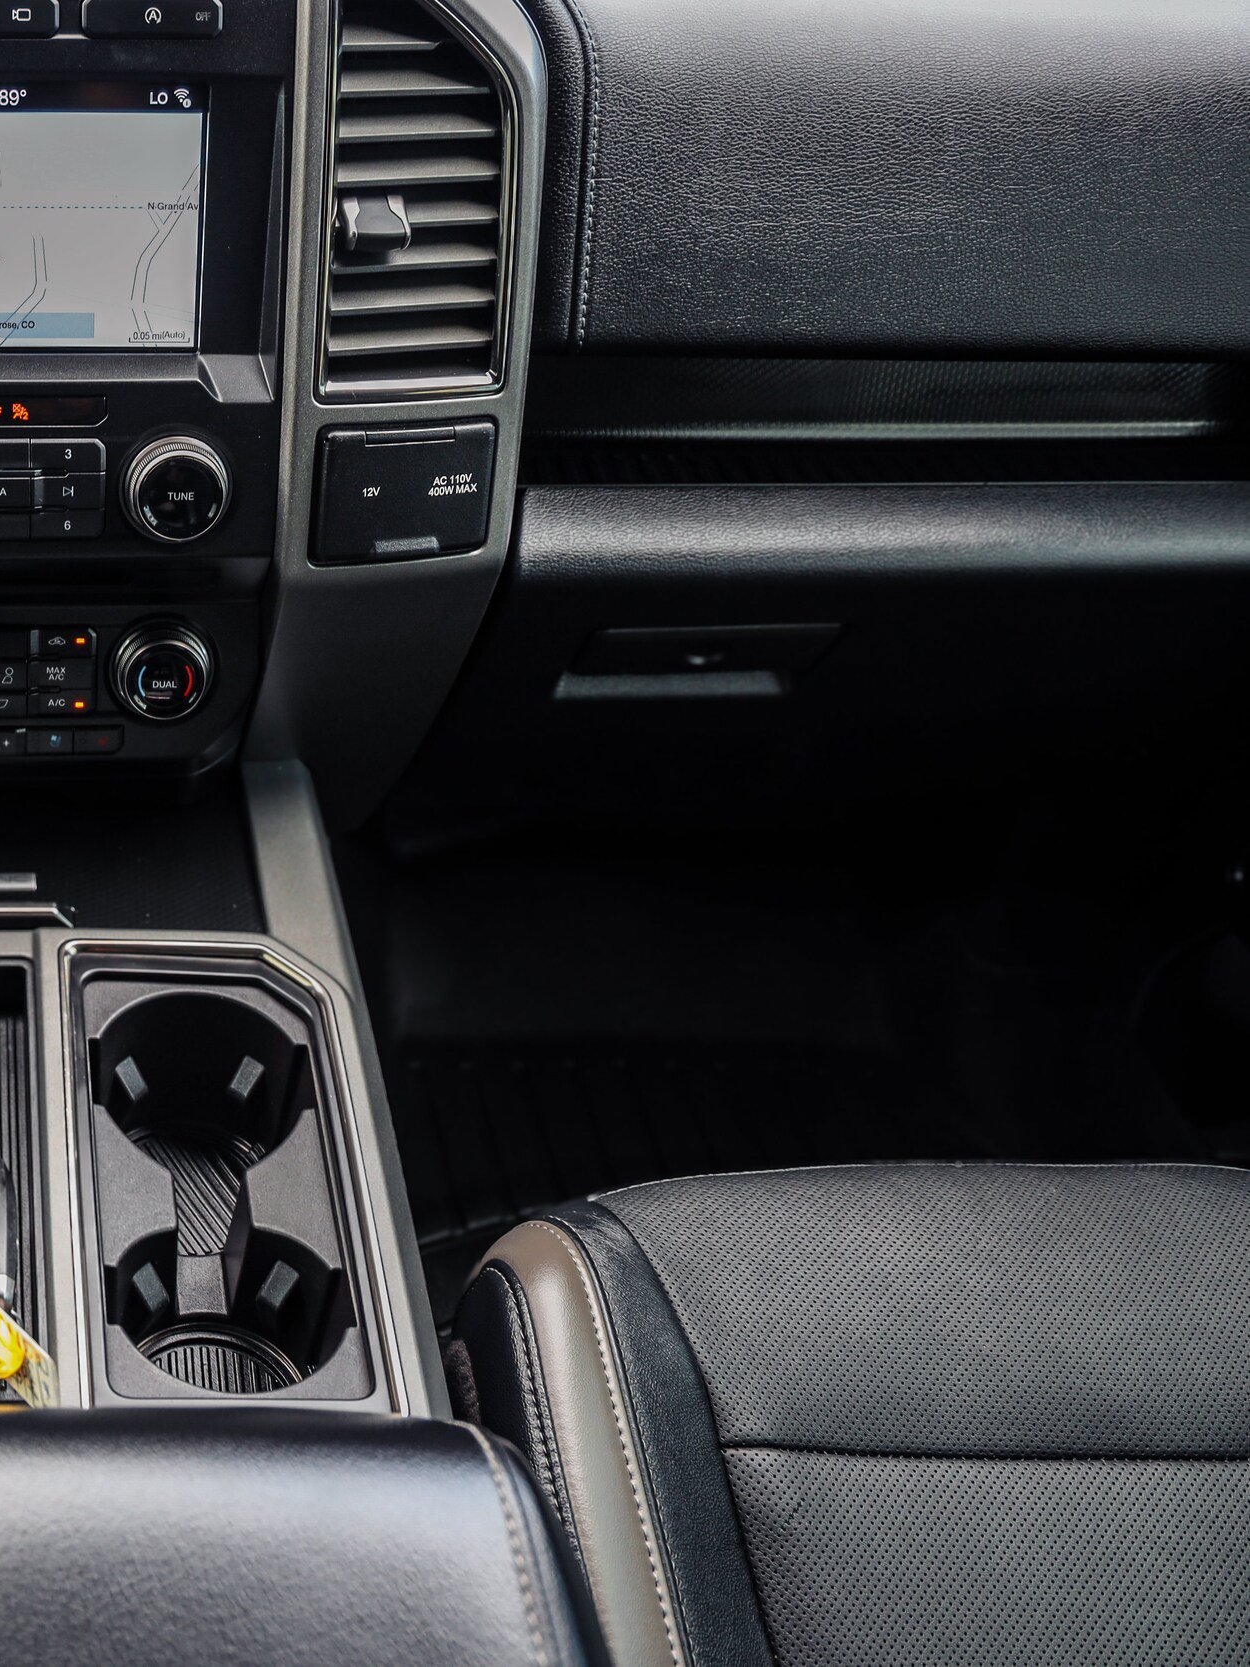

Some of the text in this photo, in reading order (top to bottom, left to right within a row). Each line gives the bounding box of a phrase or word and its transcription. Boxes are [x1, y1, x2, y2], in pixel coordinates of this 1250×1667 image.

[150, 91, 168, 105] LO
[147, 202, 155, 210] N
[157, 202, 185, 211] Grand
[21, 321, 36, 329] CO
[133, 331, 151, 340] 0.05
[64, 448, 72, 459] 3
[433, 472, 473, 487] AC 110V
[362, 486, 381, 498] 12V
[428, 482, 478, 497] 400W MAX
[167, 491, 195, 501] TUNE
[63, 520, 71, 530] 6
[46, 666, 66, 674] MAX
[48, 673, 65, 681] A/C
[152, 680, 178, 689] DUAL
[47, 698, 66, 707] A/C
